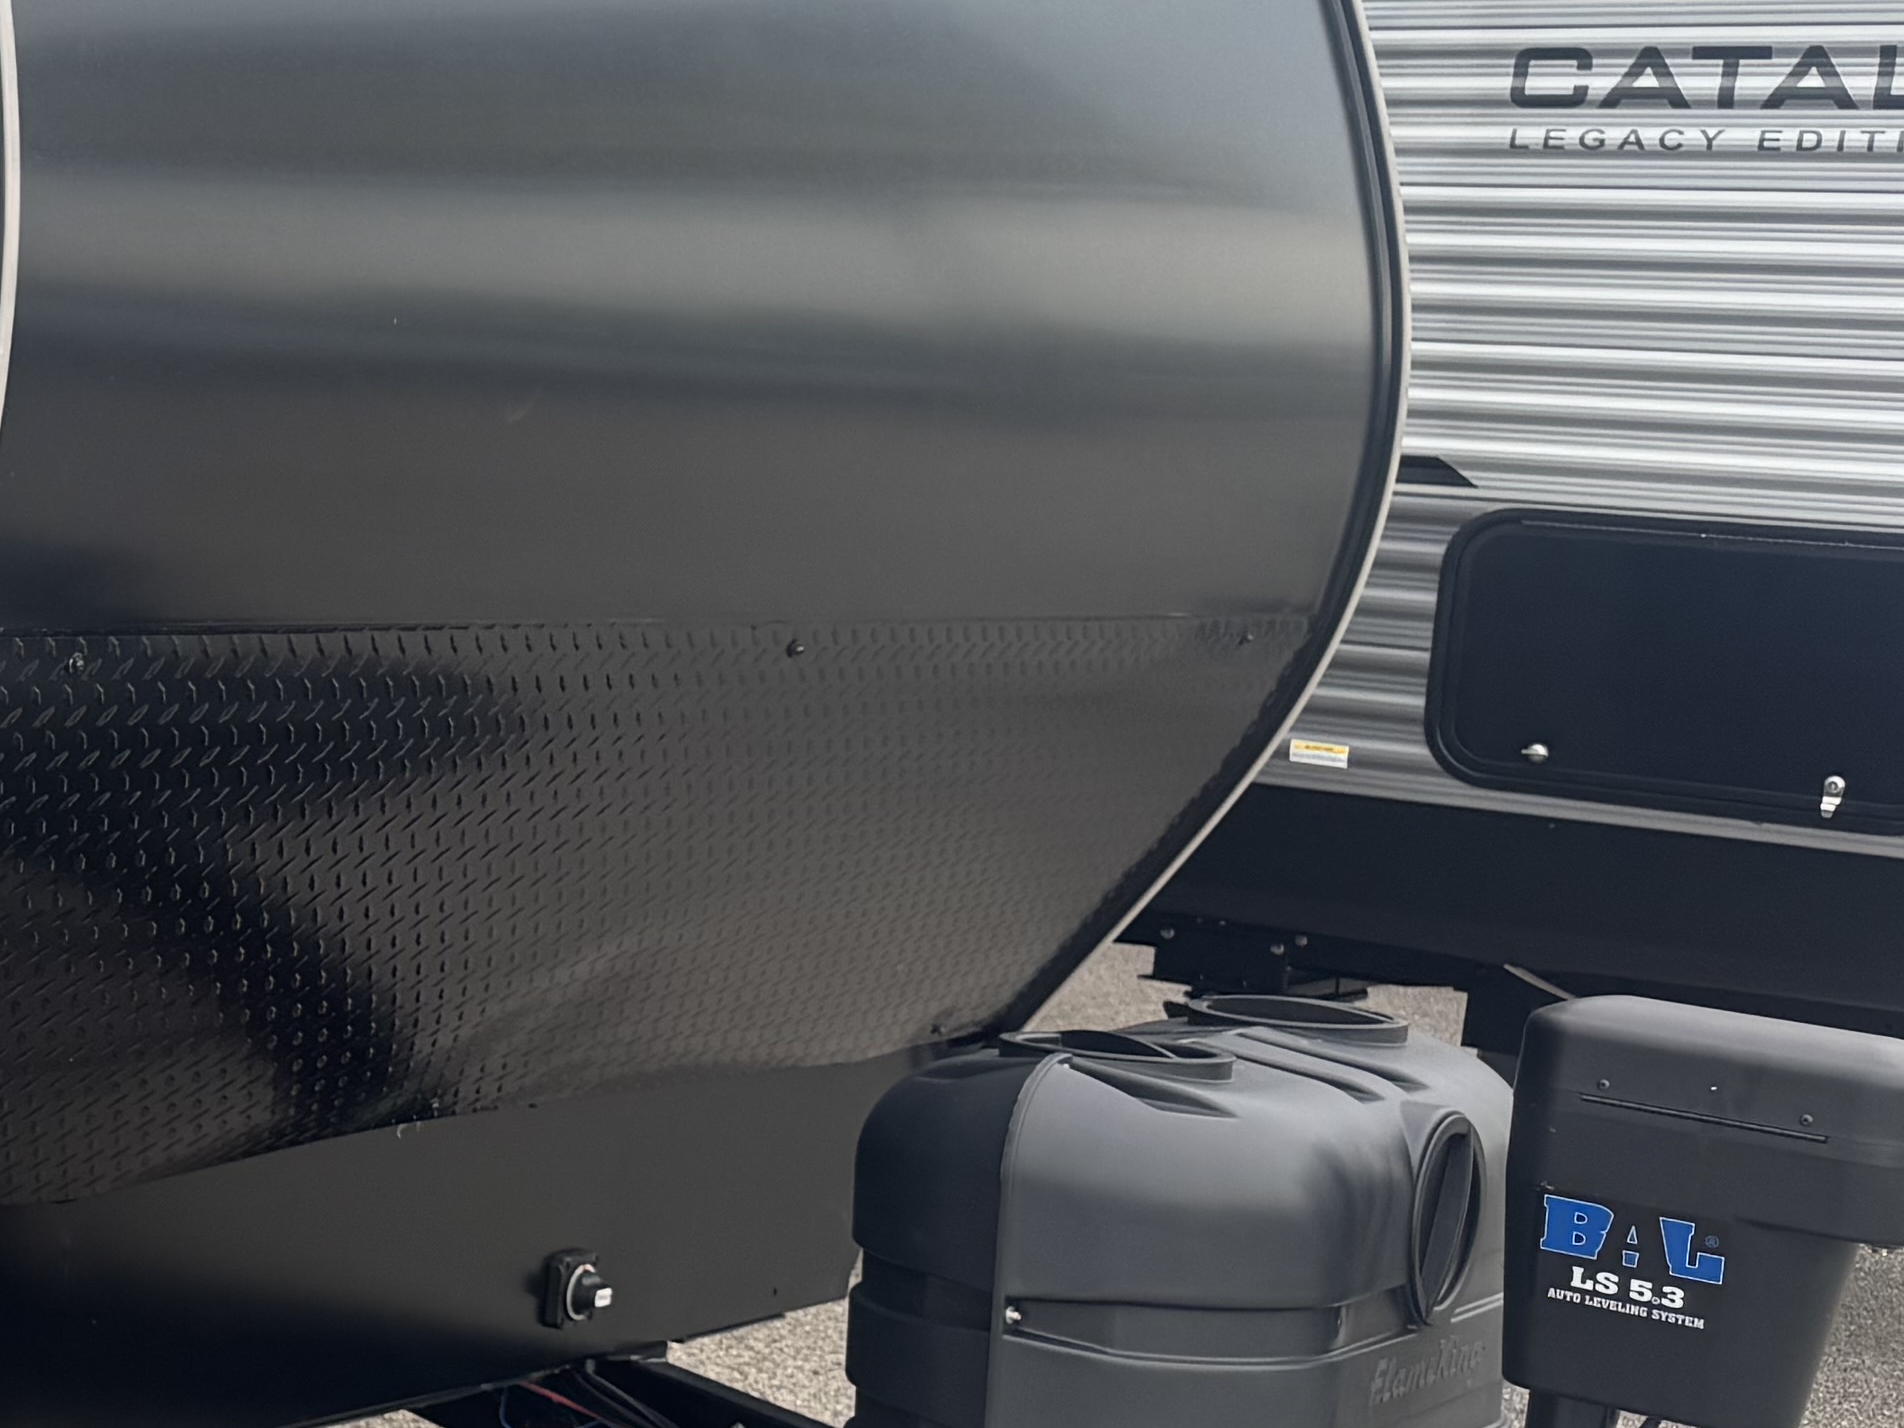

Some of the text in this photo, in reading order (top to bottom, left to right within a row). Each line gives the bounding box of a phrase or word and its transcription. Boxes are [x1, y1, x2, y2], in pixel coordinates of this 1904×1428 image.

[1508, 127, 1726, 152] LEGACY
[1540, 1193, 1725, 1285] BAL
[1547, 1287, 1705, 1329] AUTO LEVELING SYSTEM
[1570, 1265, 1685, 1309] LS 5.3
